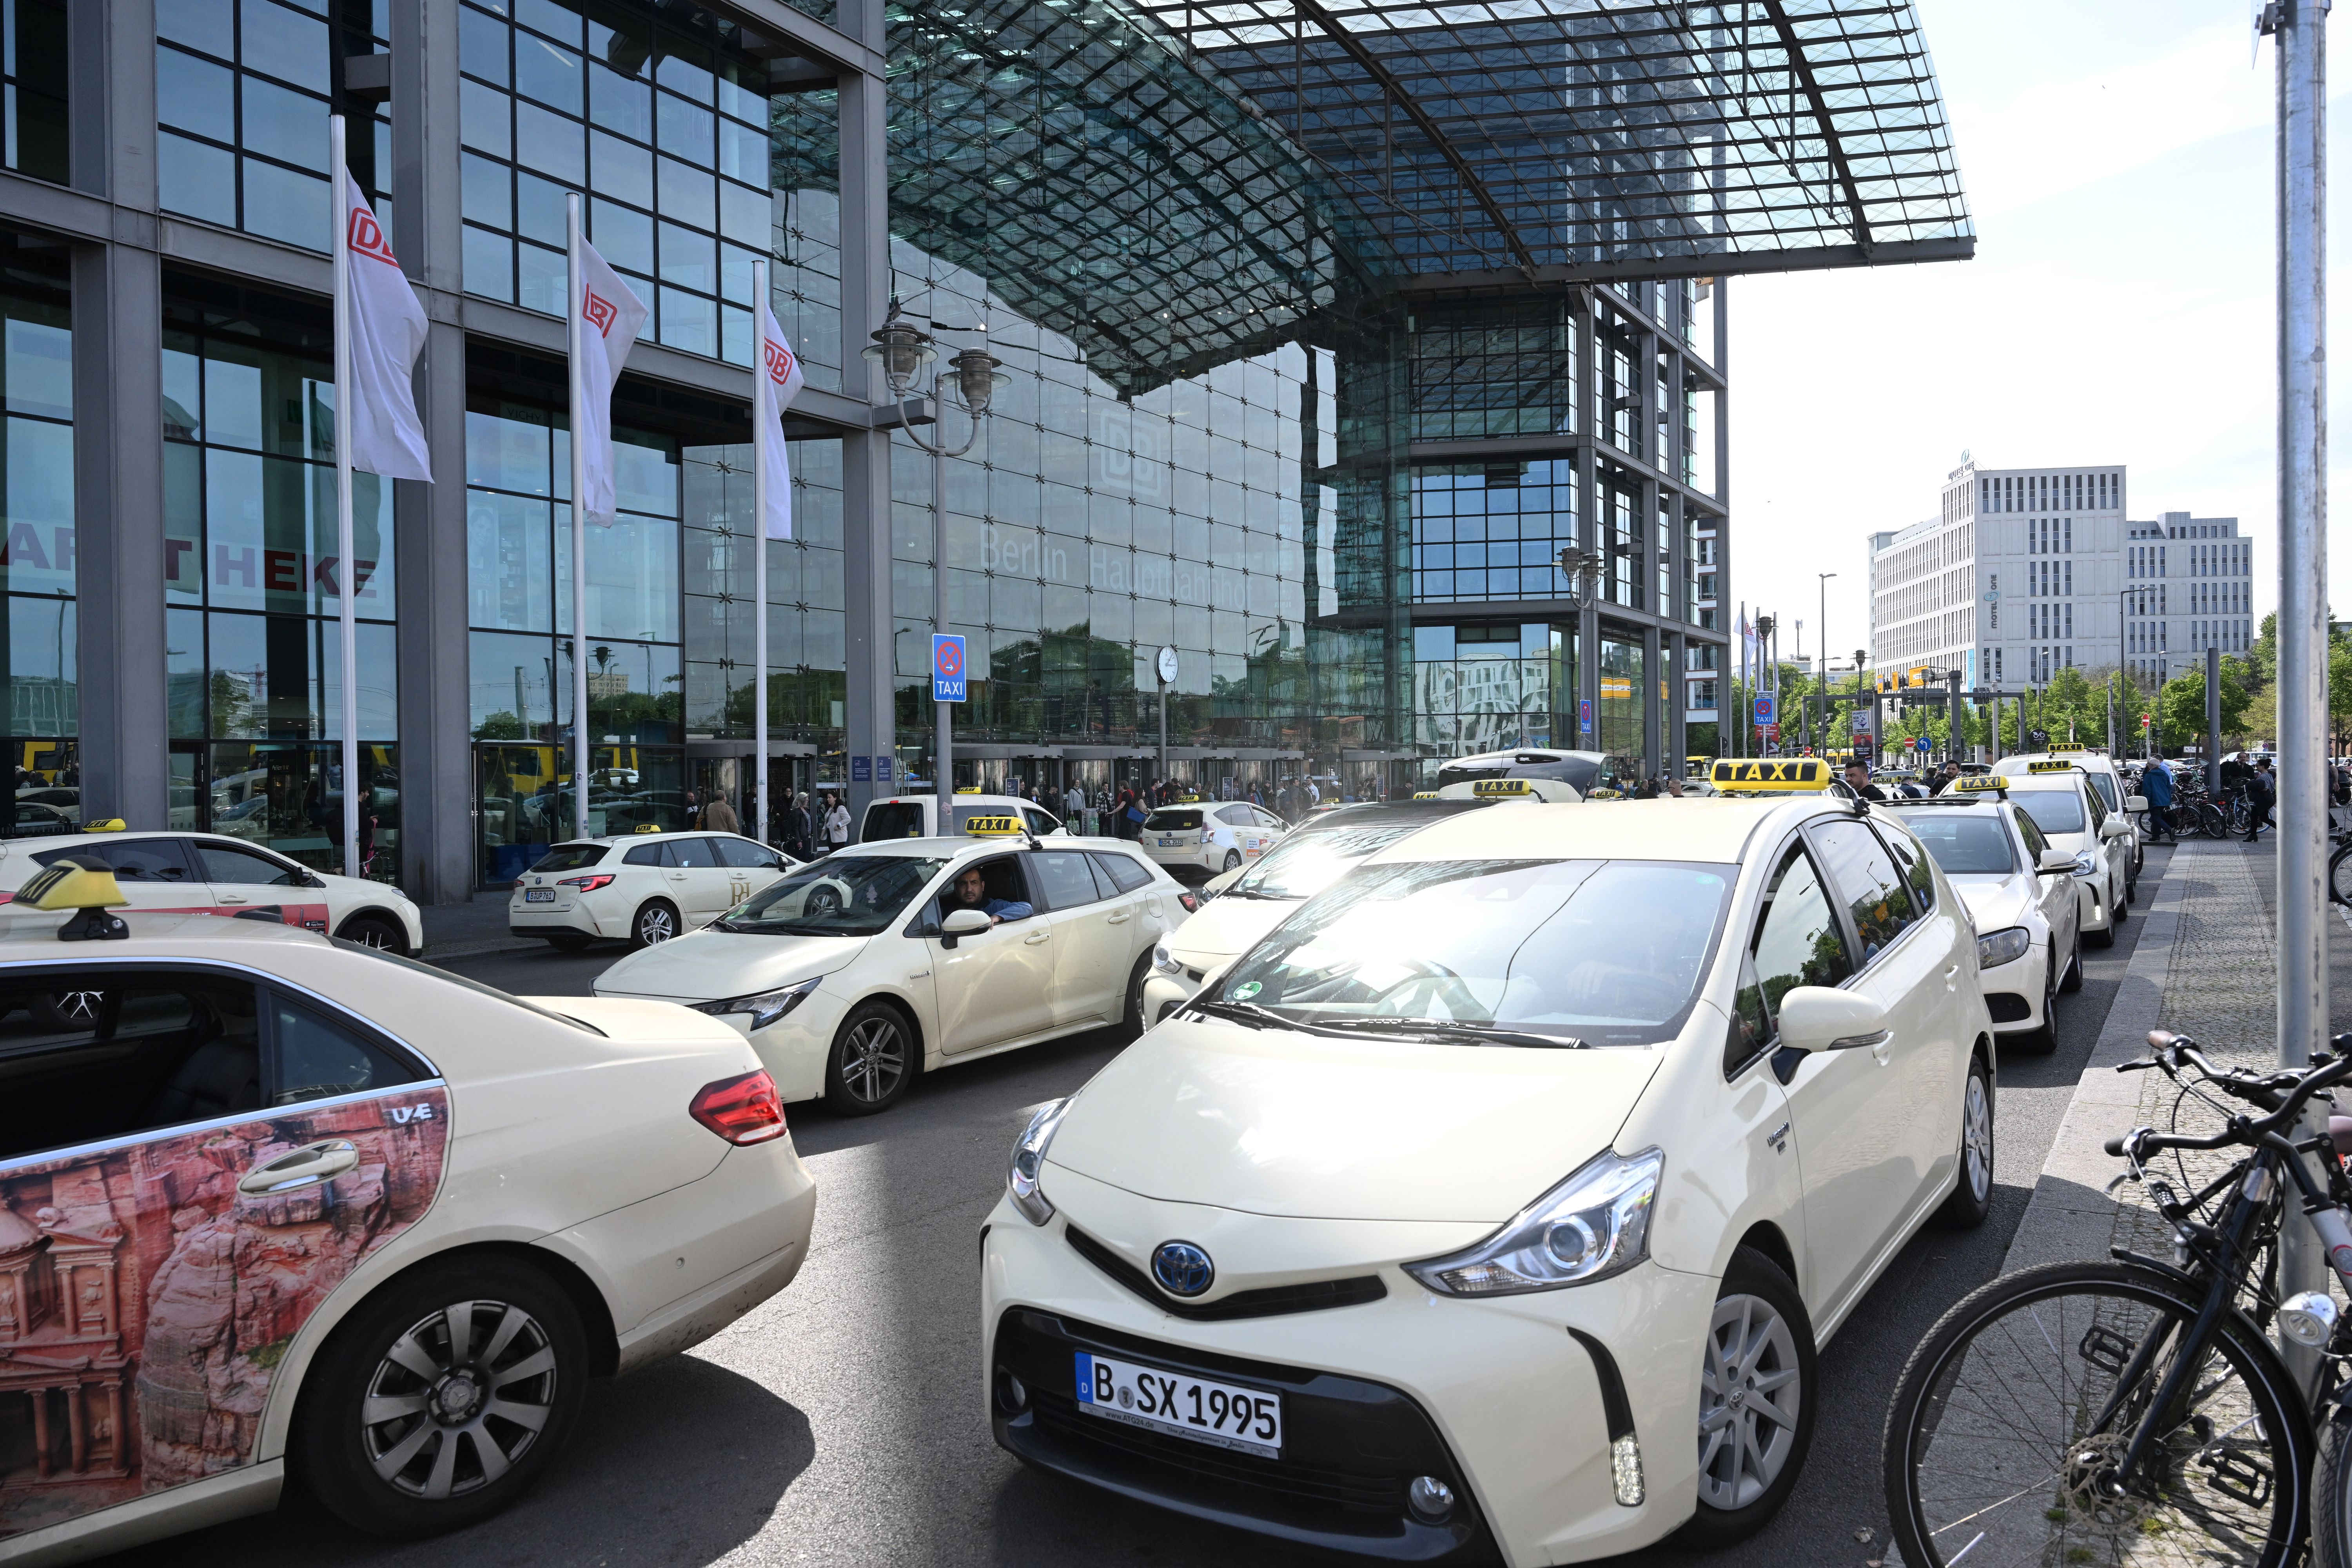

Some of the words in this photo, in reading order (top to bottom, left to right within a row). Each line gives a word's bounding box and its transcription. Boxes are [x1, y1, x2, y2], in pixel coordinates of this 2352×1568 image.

[507, 408, 541, 423] VICHY
[1109, 422, 1157, 482] DB
[980, 524, 1067, 581] Berlin
[1090, 548, 1253, 610] Hauptbahnhof
[937, 681, 963, 695] TAXI
[1728, 763, 1802, 780] TAXI
[1481, 782, 1517, 791] TAXI
[1964, 778, 1998, 788] TAXI
[86, 820, 109, 828] TAXI
[973, 820, 1005, 829] TAXI
[1081, 1382, 1088, 1394] D
[1095, 1362, 1114, 1402] B
[1137, 1373, 1179, 1420] SX
[1188, 1385, 1276, 1440] 1995
[1105, 1412, 1154, 1429] www.ATG24.de
[1178, 1429, 1220, 1444] Autoteilepartner
[1227, 1440, 1245, 1450] Berlin
